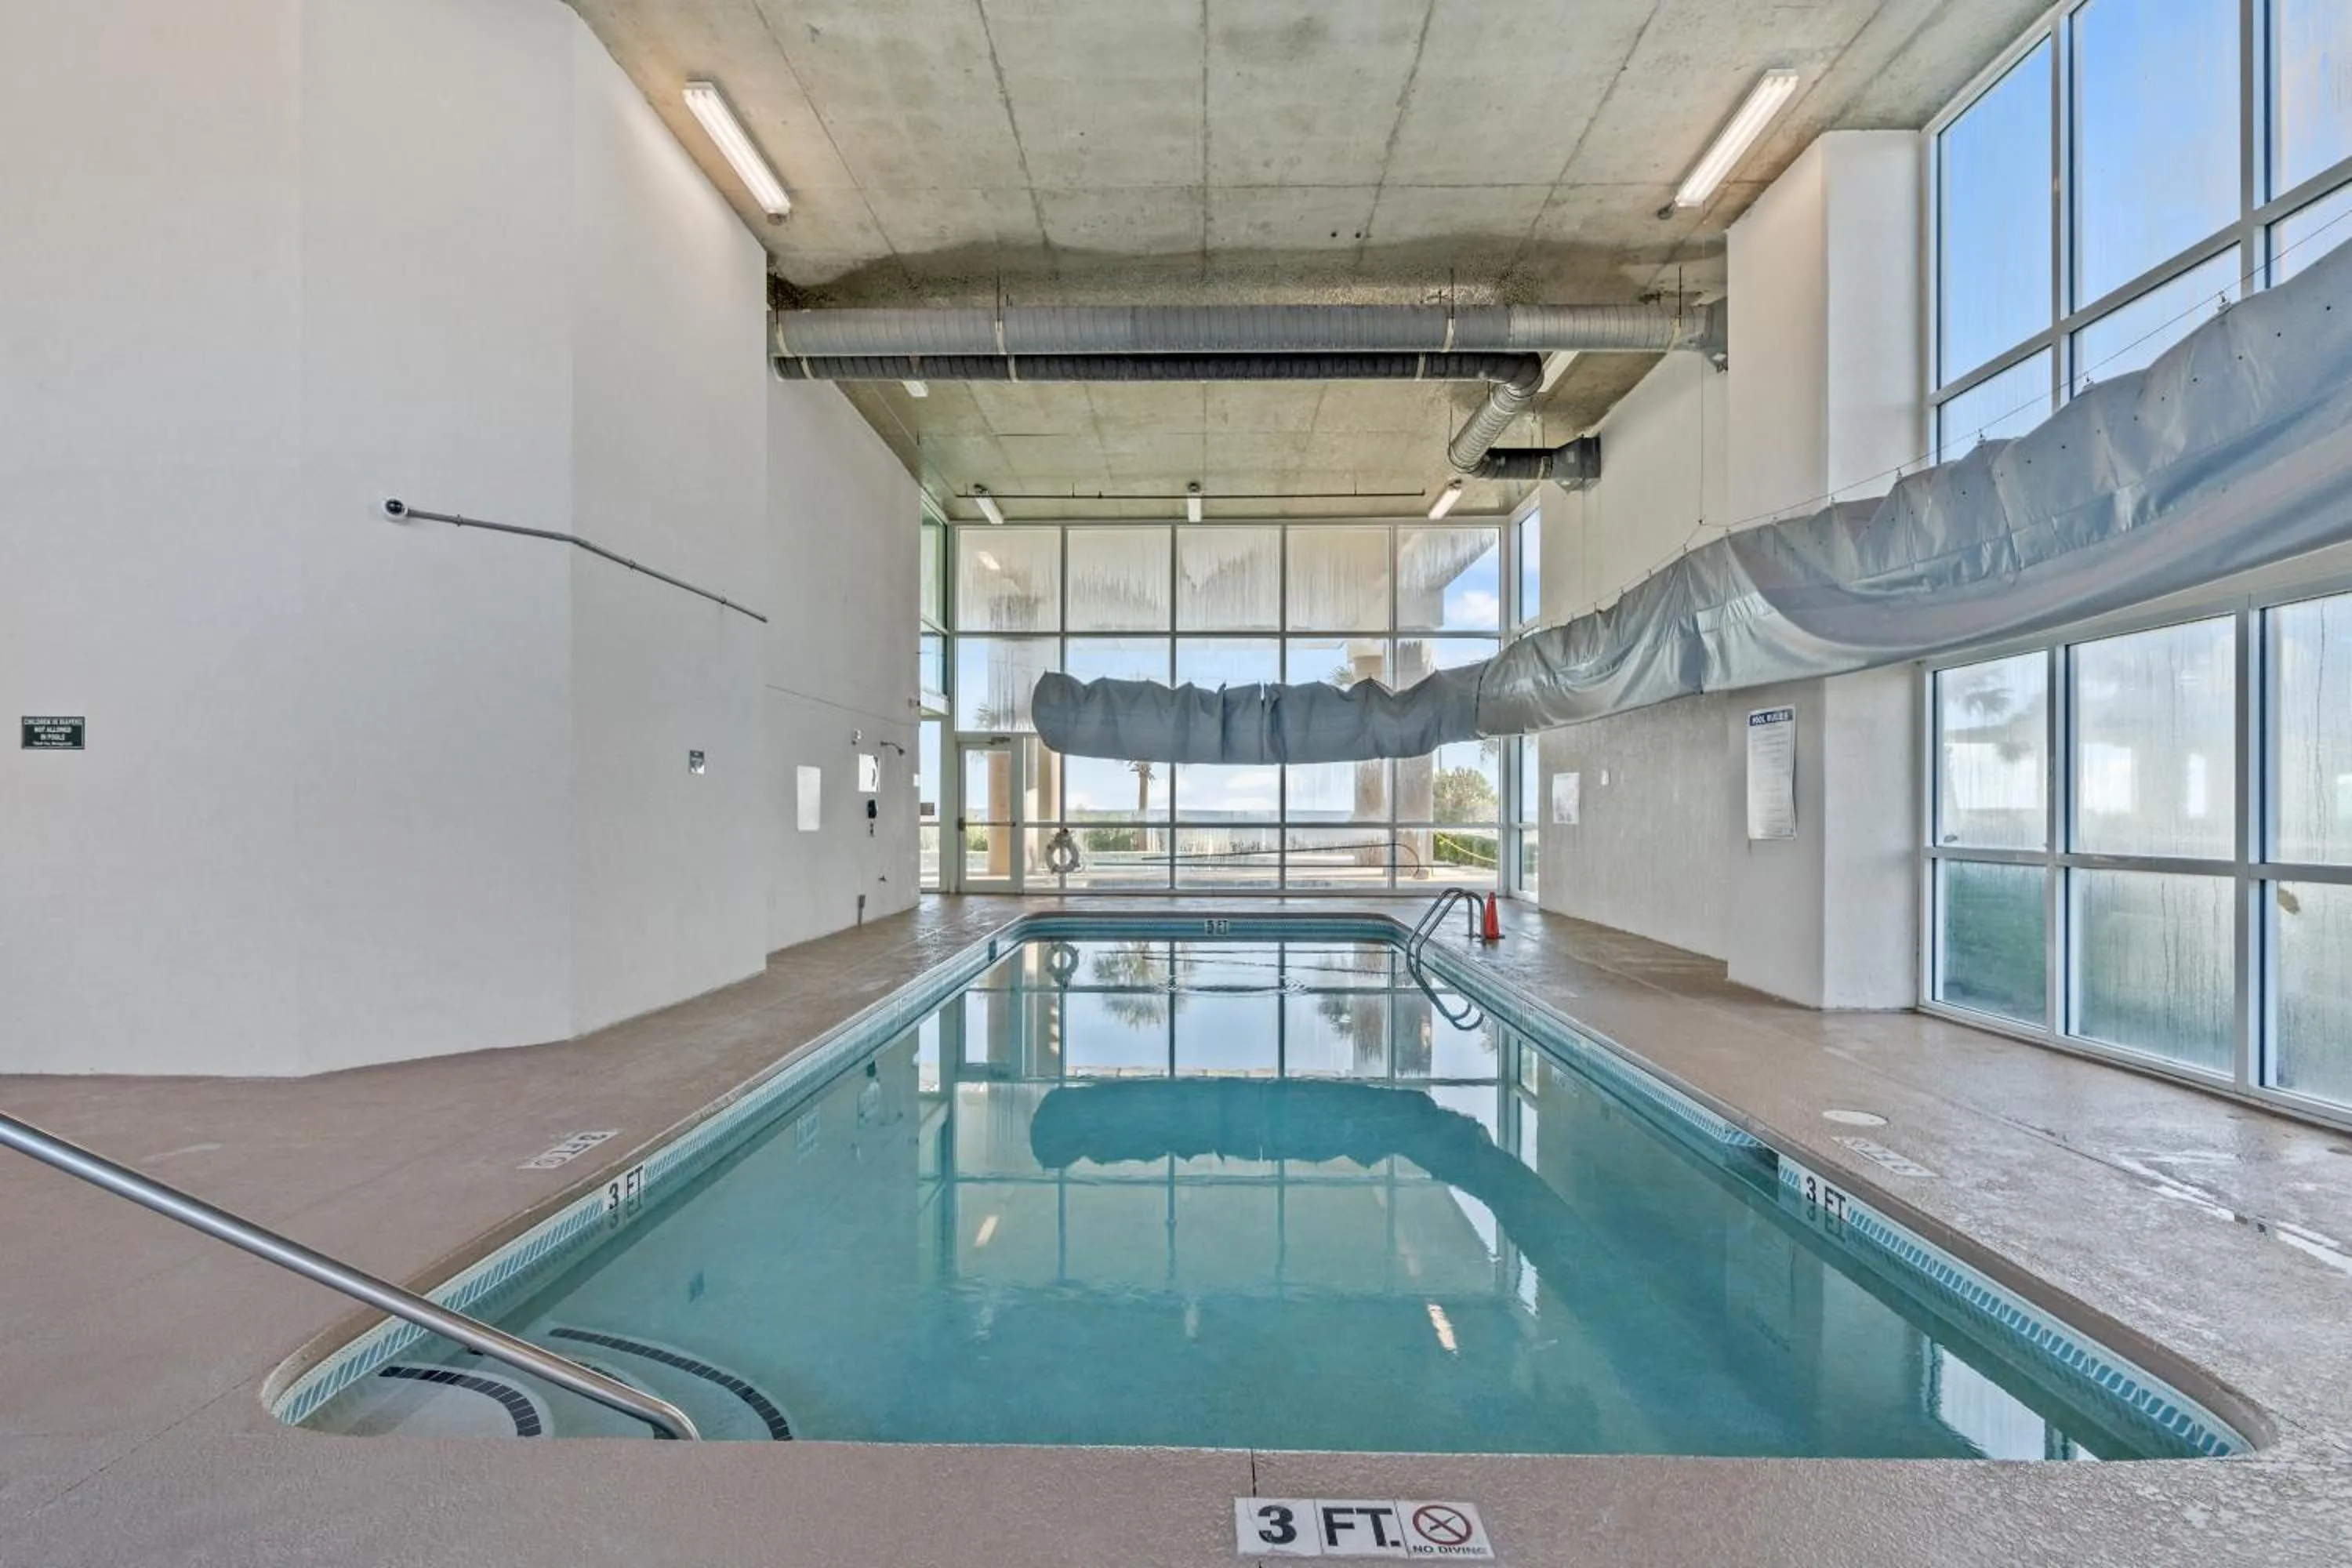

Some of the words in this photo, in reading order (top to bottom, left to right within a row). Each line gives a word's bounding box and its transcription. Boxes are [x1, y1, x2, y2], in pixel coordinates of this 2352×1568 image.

[609, 1182, 619, 1210] 3
[627, 1165, 643, 1199] FT
[1806, 1176, 1816, 1203] 3
[1825, 1185, 1846, 1220] FT
[1258, 1504, 1298, 1545] 3
[1322, 1508, 1401, 1548] FT.
[1437, 1545, 1487, 1555] DIVING
